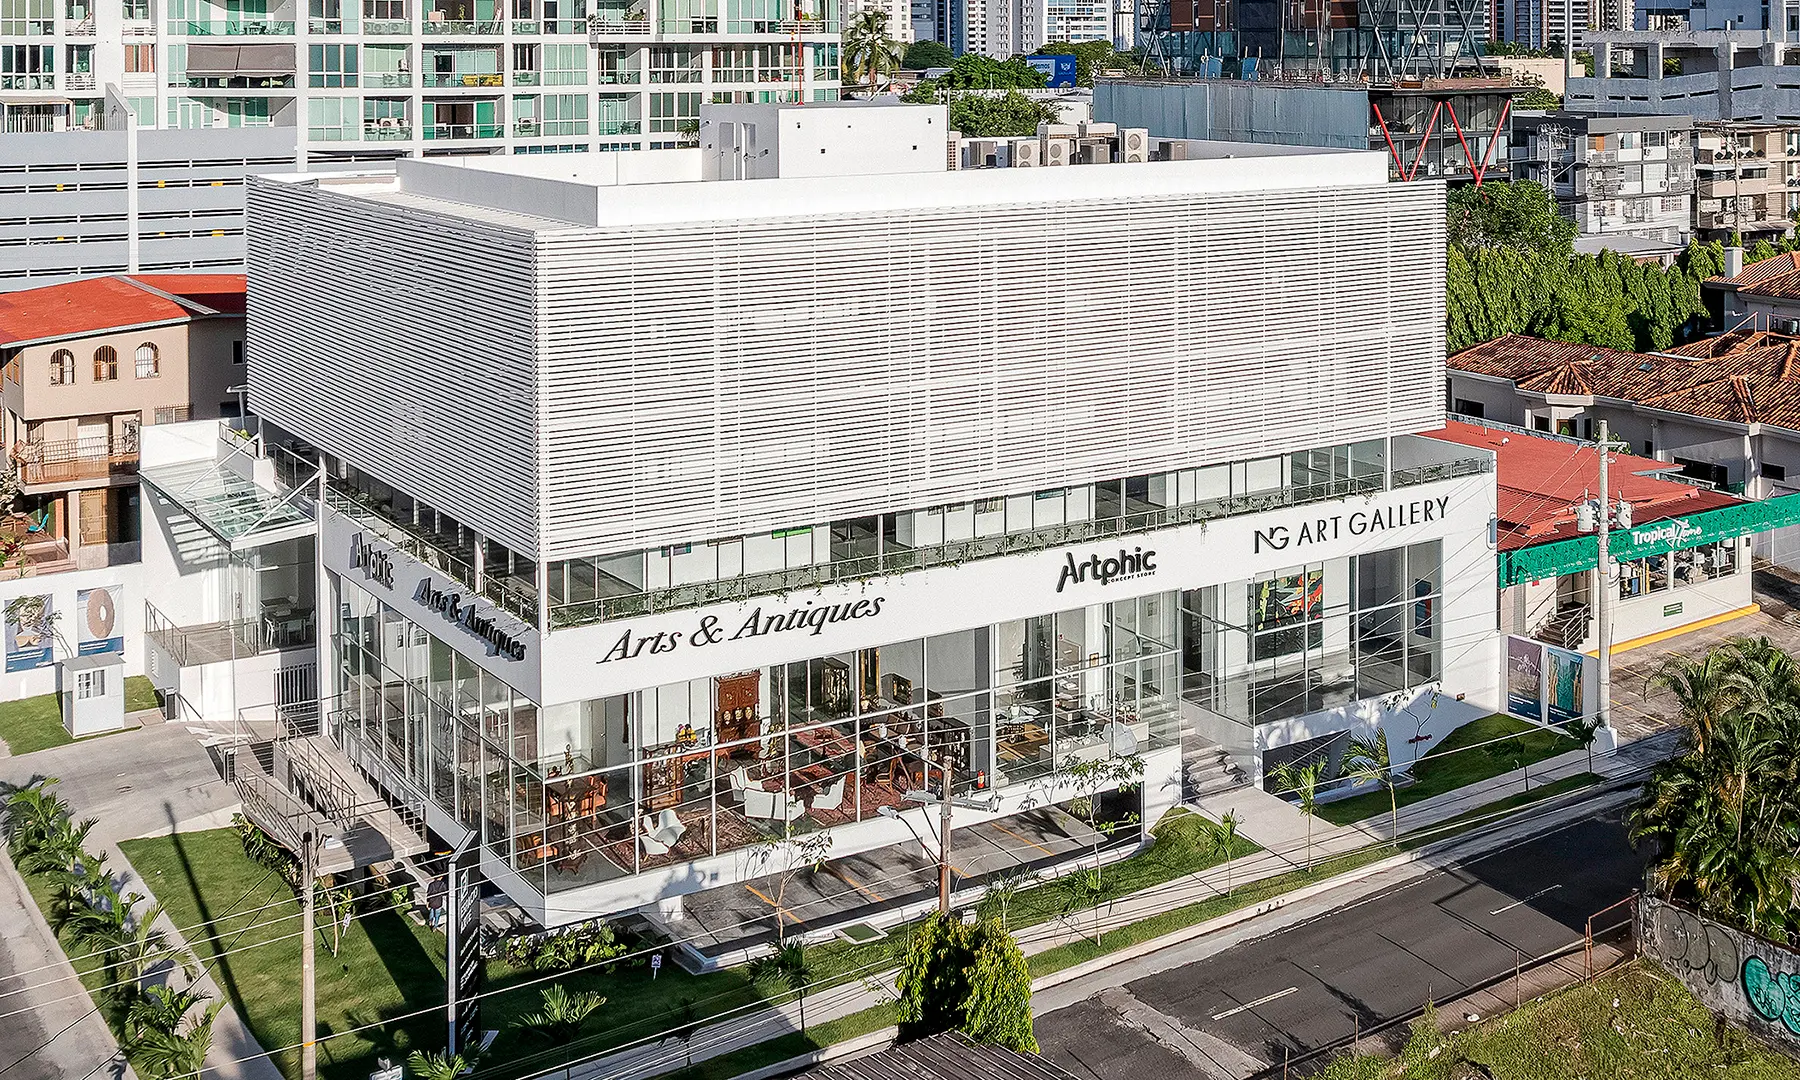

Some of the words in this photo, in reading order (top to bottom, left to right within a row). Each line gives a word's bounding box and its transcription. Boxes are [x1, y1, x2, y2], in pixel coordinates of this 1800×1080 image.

[1254, 526, 1290, 554] NG
[1297, 515, 1342, 546] ART
[1349, 496, 1449, 535] GALLERY
[1632, 523, 1675, 545] Tropical
[1665, 519, 1702, 549] Home
[350, 532, 394, 582] Artphic
[1056, 546, 1157, 592] Artphic
[1107, 574, 1134, 583] CONCEPT
[414, 576, 450, 612] Arts
[457, 603, 527, 662] Antiques
[596, 628, 682, 664] Arts
[689, 614, 723, 647] &
[728, 596, 886, 641] Antiques
